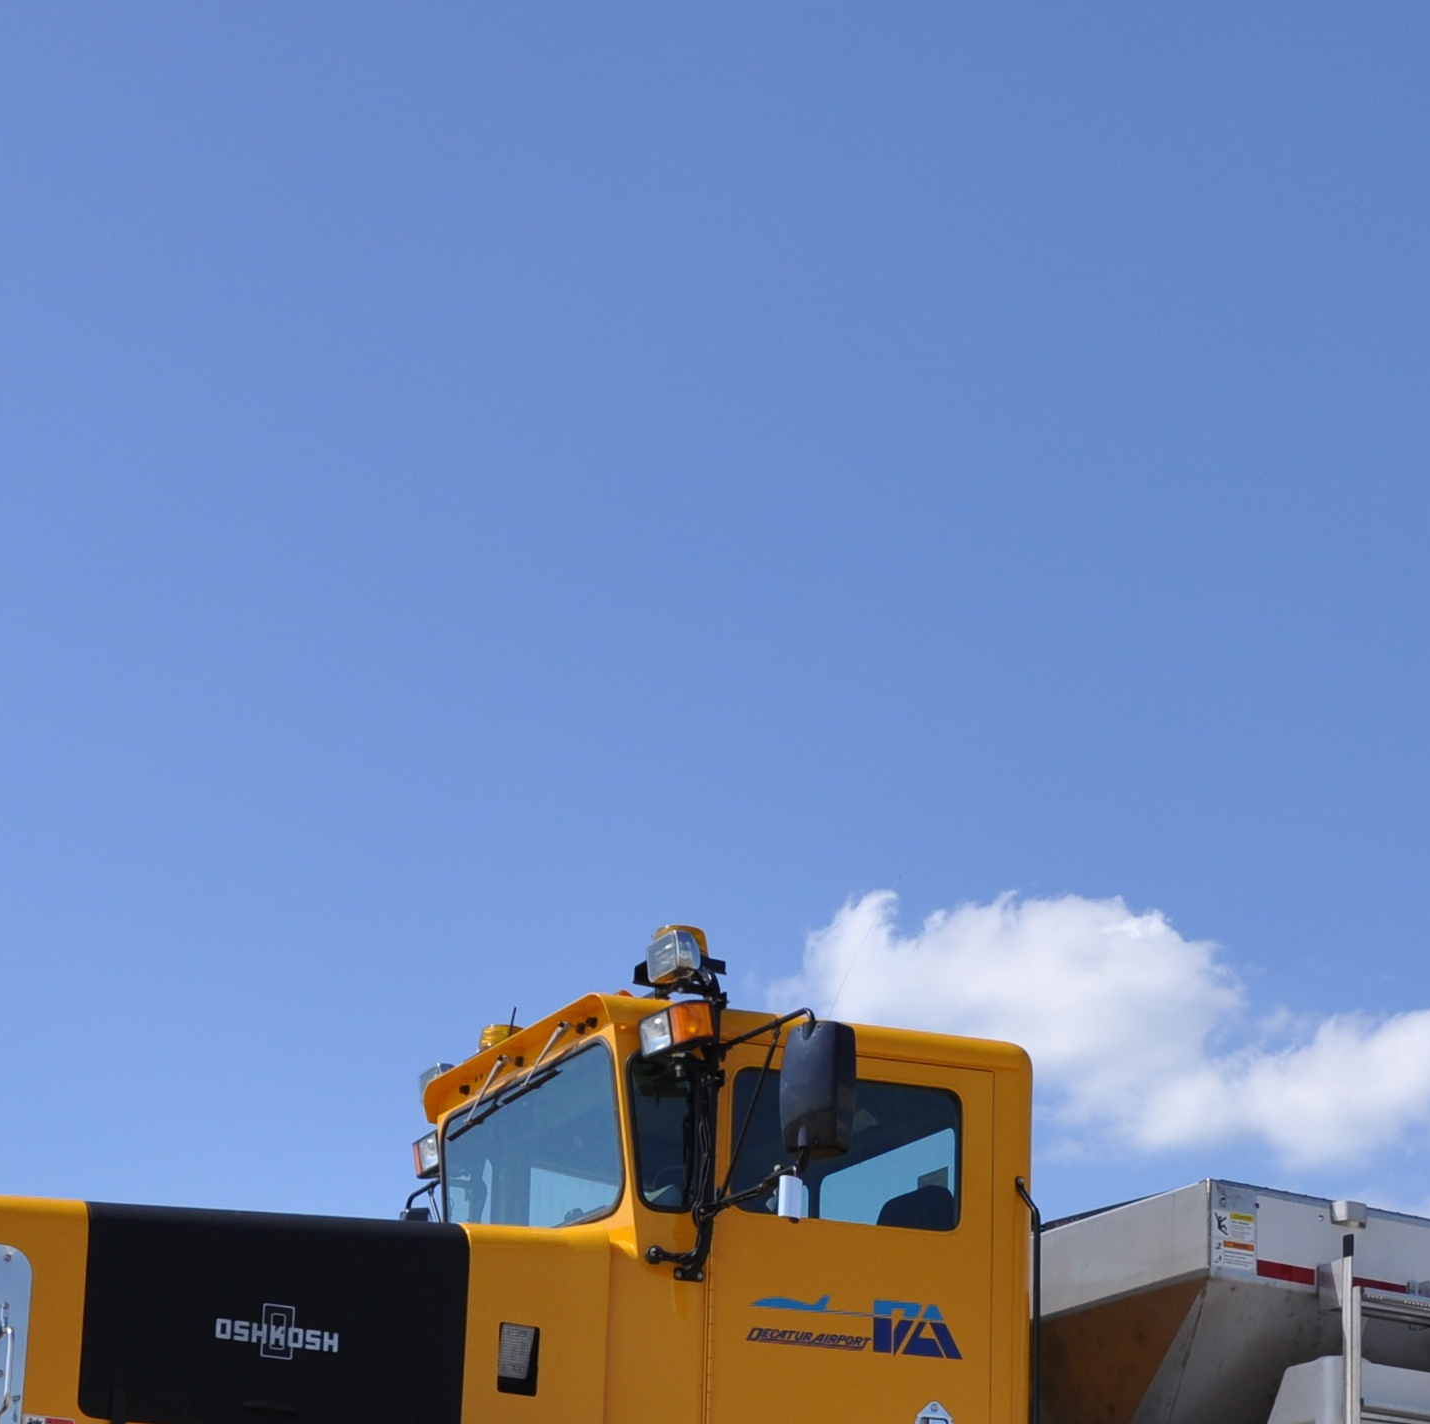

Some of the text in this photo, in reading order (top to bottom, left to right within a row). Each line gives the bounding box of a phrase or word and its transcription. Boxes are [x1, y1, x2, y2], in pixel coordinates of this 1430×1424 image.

[215, 1318, 339, 1353] OSHKOSH
[746, 1327, 871, 1349] DECATUR AIRPORT
